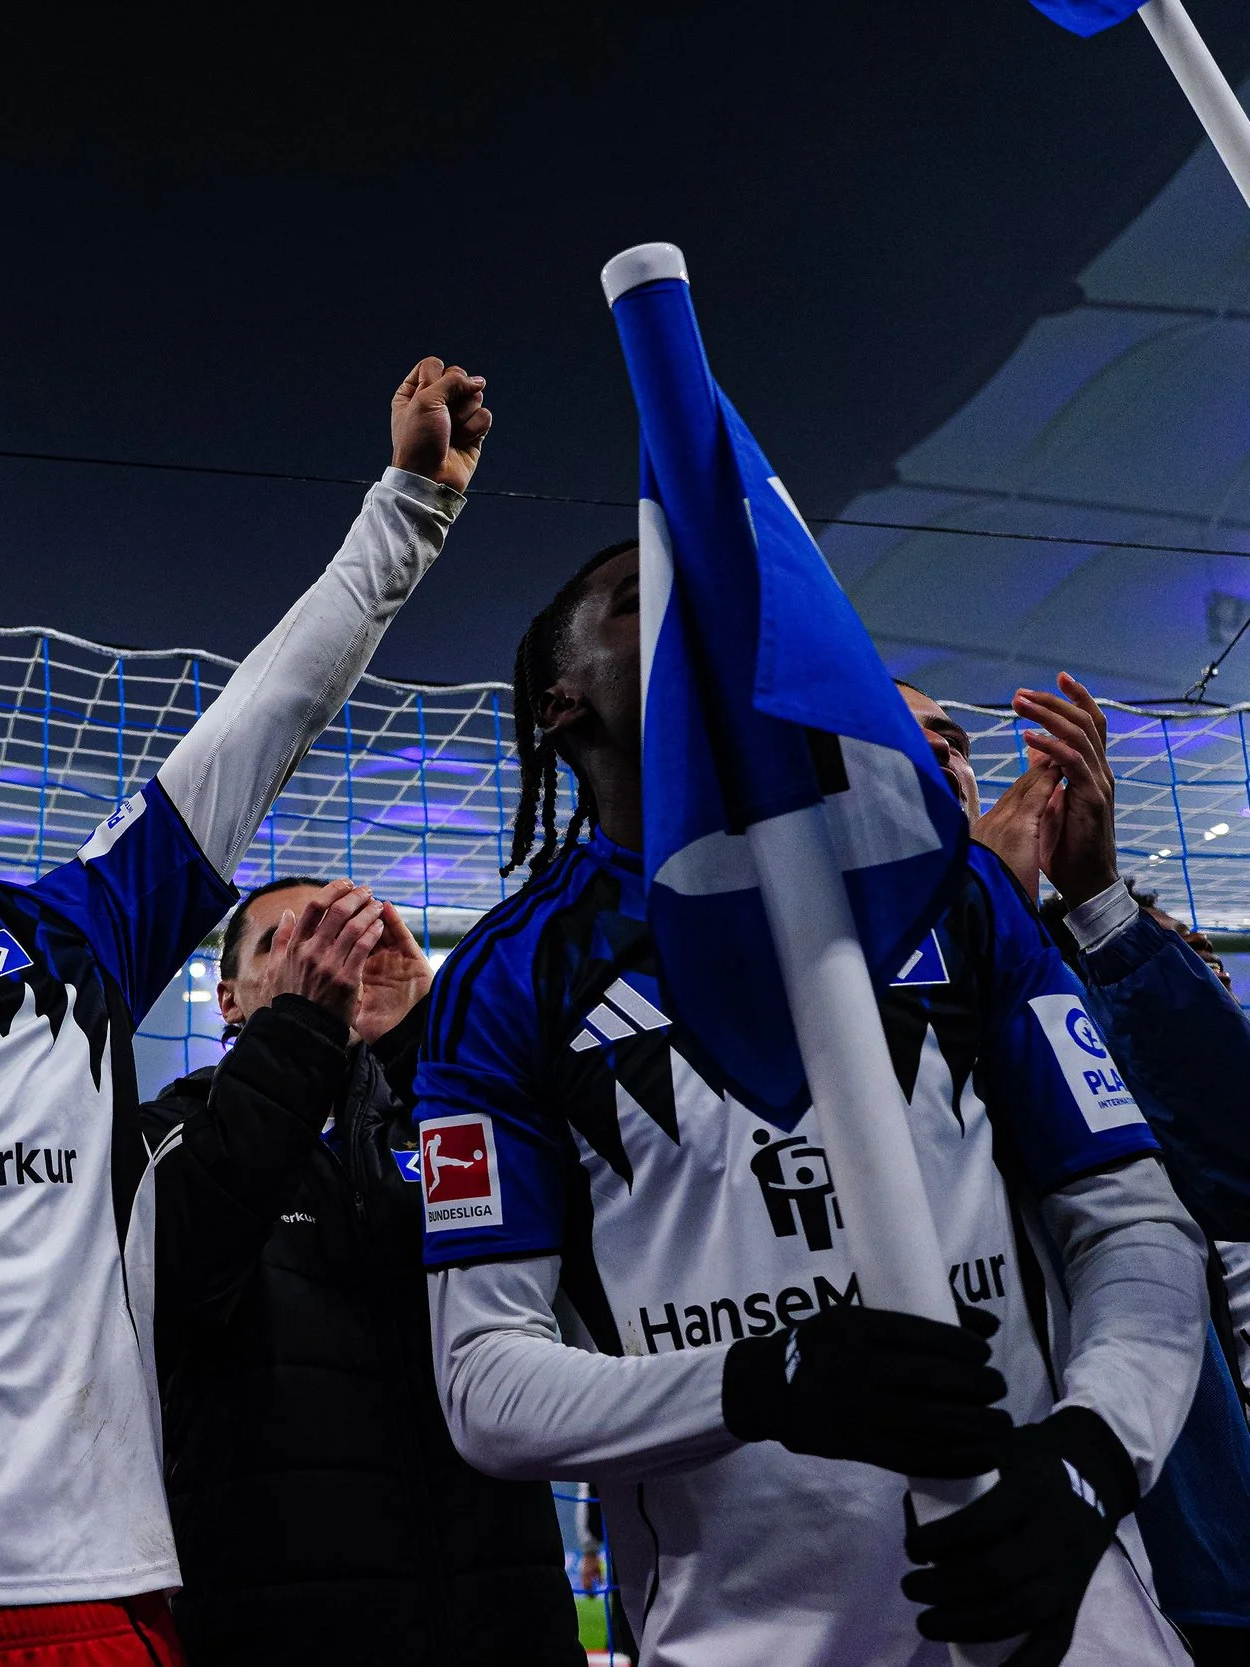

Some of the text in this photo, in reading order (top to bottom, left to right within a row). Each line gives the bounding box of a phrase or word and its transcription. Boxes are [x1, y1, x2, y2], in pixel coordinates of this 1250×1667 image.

[1083, 1068, 1128, 1095] PLA
[280, 1212, 316, 1224] erkur
[428, 1205, 493, 1223] BUNDESLIGA
[640, 1253, 1005, 1355] HanseMkur
